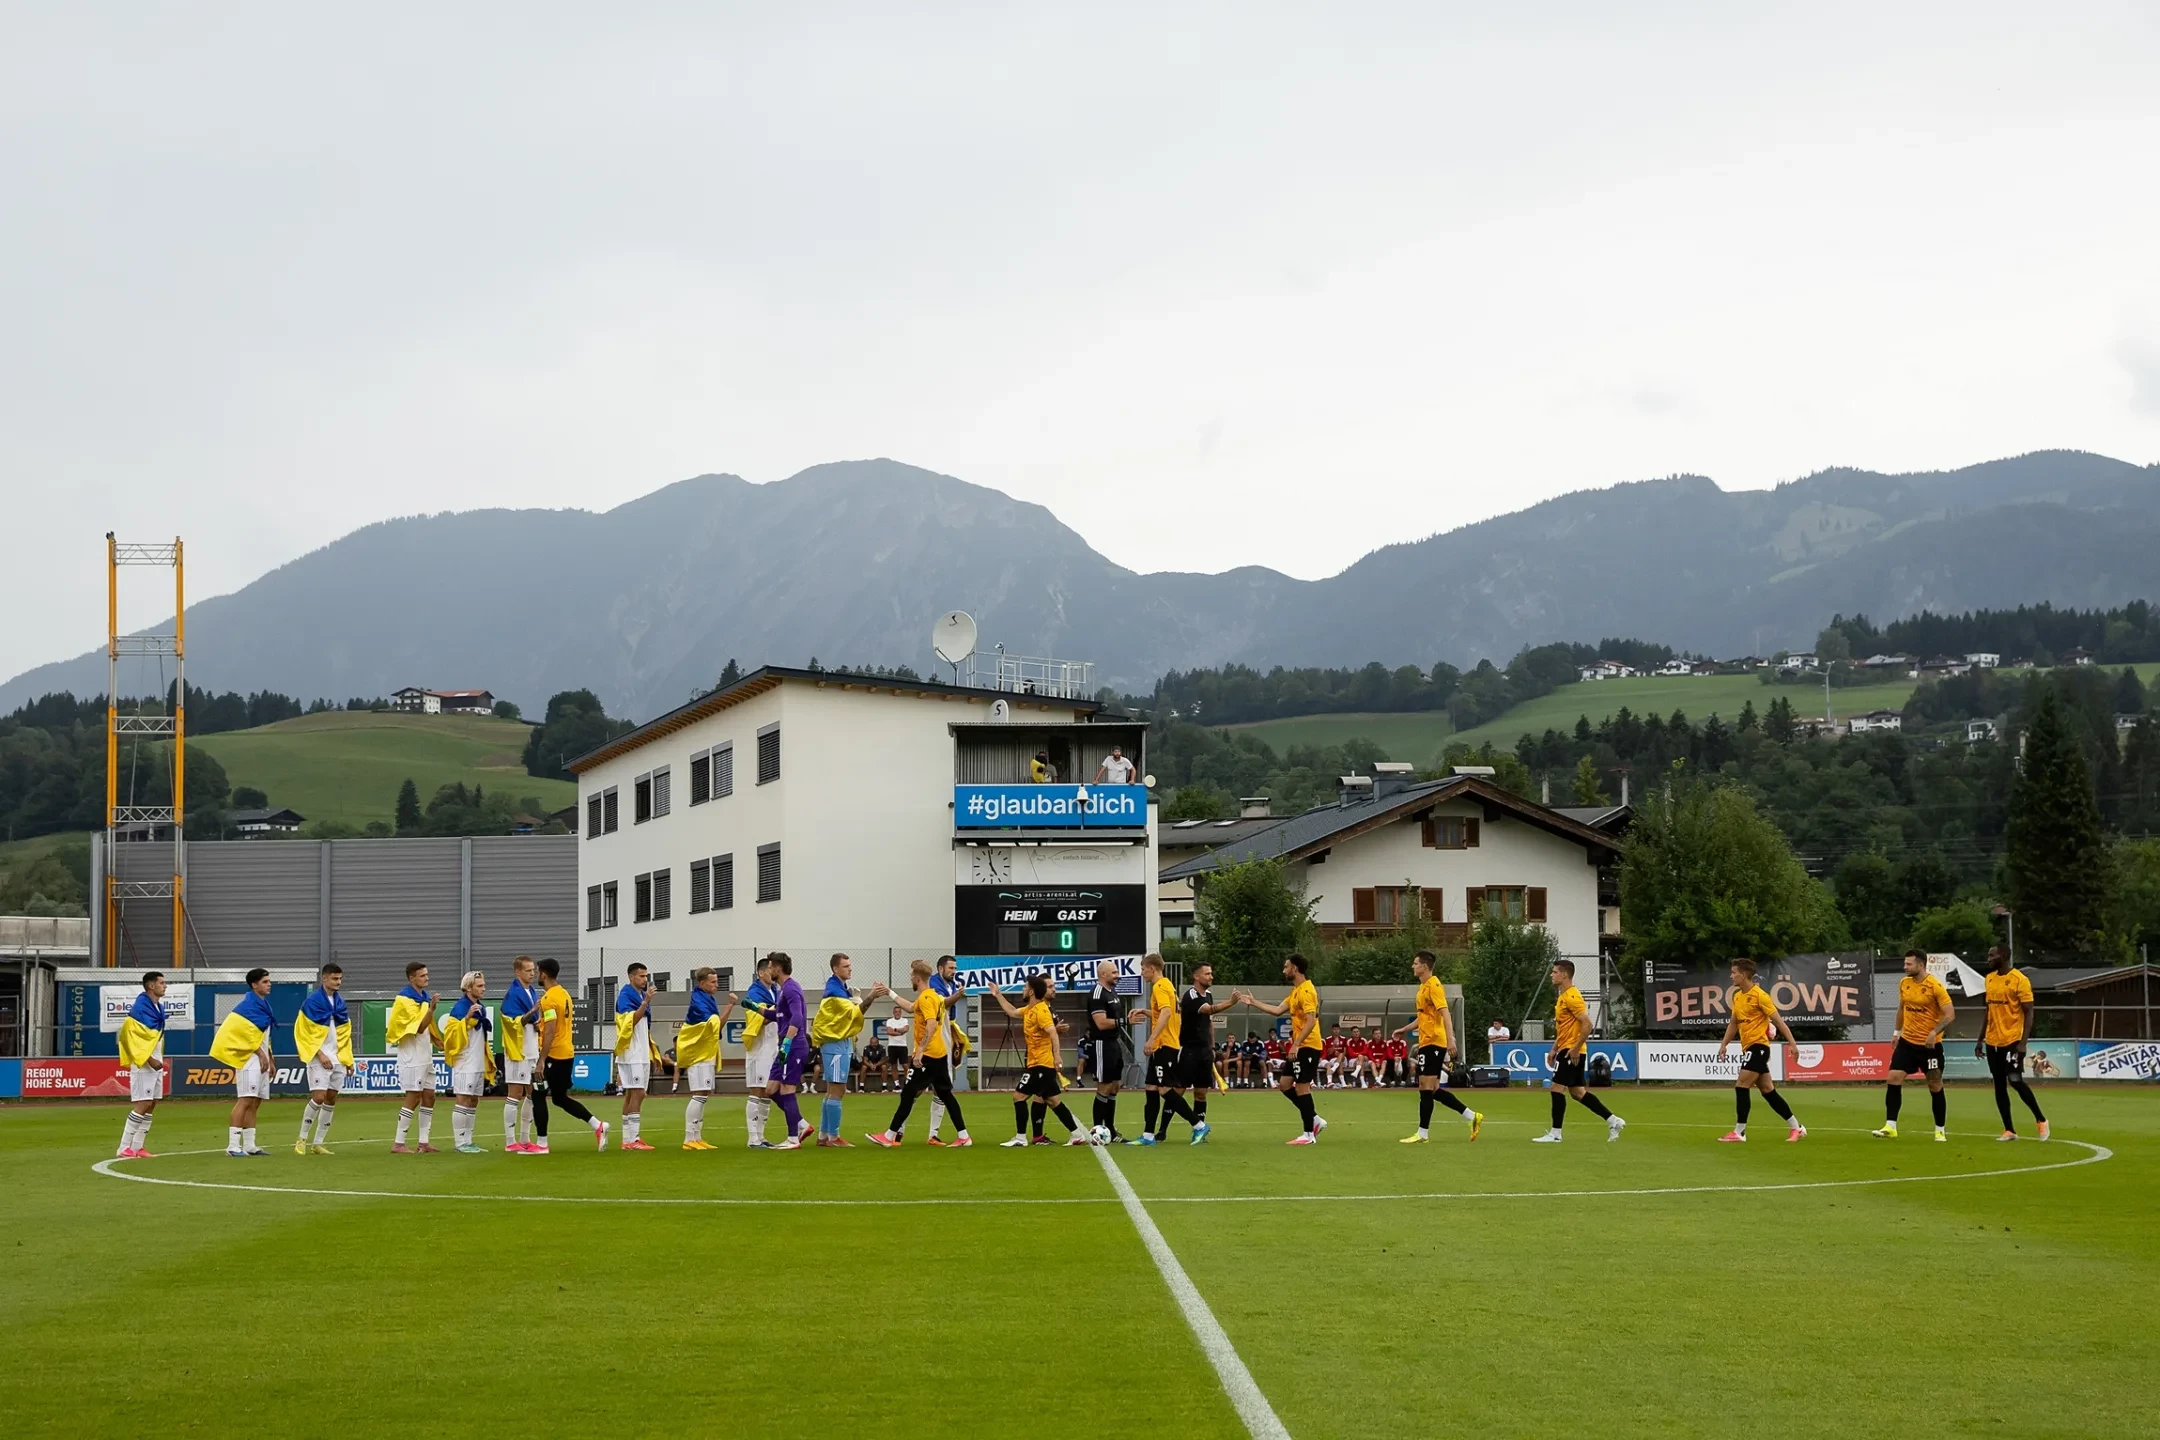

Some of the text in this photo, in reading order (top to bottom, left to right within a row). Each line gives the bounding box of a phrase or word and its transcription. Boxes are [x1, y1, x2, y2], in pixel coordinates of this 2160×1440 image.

[968, 794, 1135, 819] #glaubandich
[1004, 910, 1097, 921] HEIM GAST
[1061, 931, 1072, 948] 0
[955, 962, 1040, 989] SANITÄR
[1656, 975, 1860, 1022] BERÖWE
[1650, 1053, 1744, 1063] MONTANWERKE
[1842, 1059, 1882, 1067] Markthalle
[1927, 1058, 1938, 1069] 18
[2098, 1044, 2160, 1074] SANITÄR
[26, 1068, 62, 1078] REGION
[1849, 1067, 1876, 1075] WÖRGL
[26, 1077, 86, 1088] HOHE SALVE
